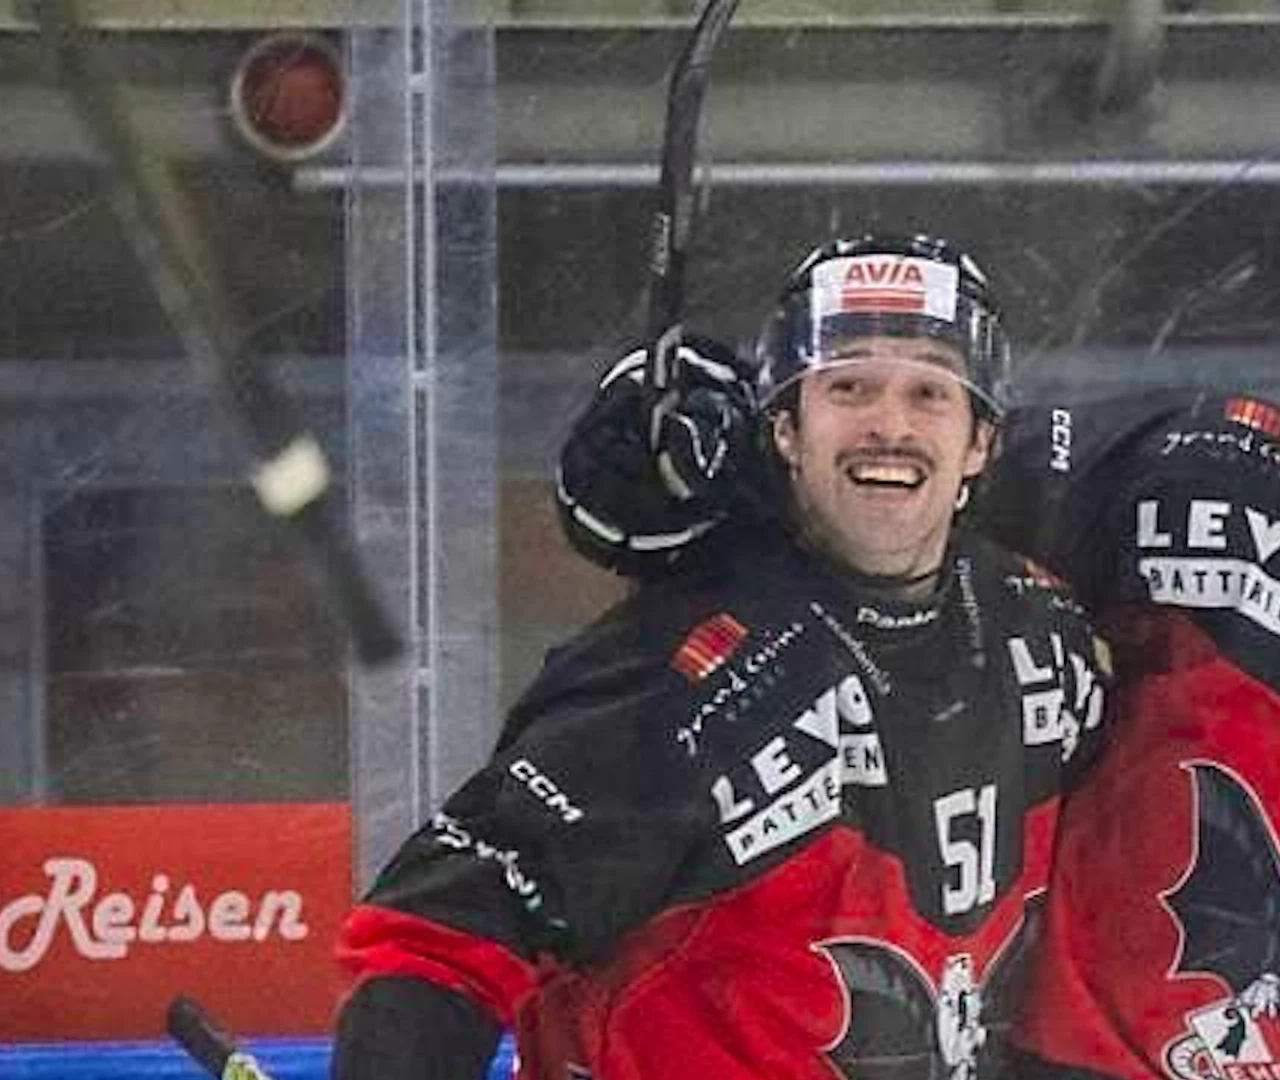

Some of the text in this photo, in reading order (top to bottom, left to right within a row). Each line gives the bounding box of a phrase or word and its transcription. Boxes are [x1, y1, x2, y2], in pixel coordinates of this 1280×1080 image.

[843, 262, 924, 285] AVIA
[1050, 408, 1071, 472] CCM
[509, 759, 584, 823] CCM
[710, 673, 872, 824] LEVO
[738, 743, 881, 850] BATTEEN
[933, 784, 998, 915] 51
